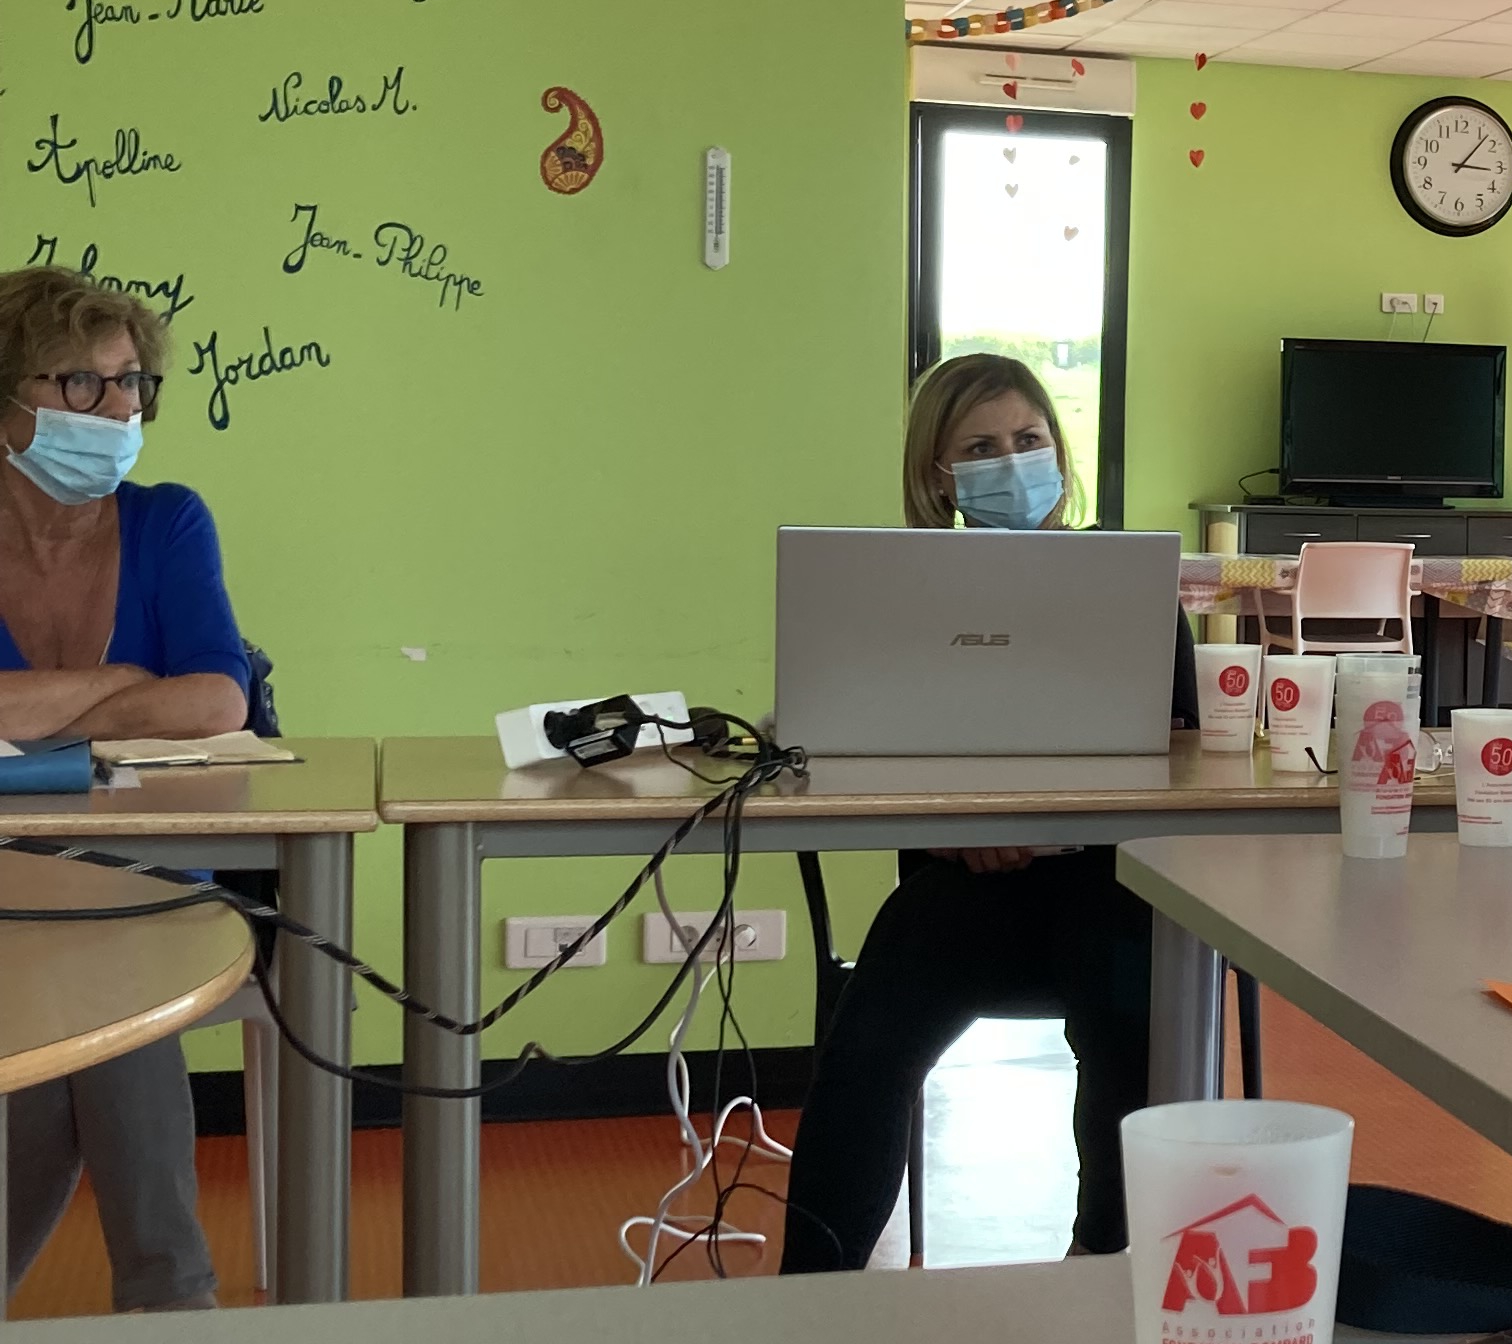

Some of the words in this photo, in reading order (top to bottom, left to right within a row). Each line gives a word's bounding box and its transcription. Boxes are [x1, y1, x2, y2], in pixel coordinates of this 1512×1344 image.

[258, 71, 367, 123] Nicolas
[1438, 125, 1451, 139] 11
[1454, 119, 1470, 134] 12
[1424, 139, 1440, 154] 10
[1488, 140, 1498, 154] 2
[27, 113, 183, 209] Apolline
[1417, 156, 1428, 170] 9
[1494, 161, 1505, 175] 3
[1422, 176, 1433, 190] 8
[1486, 180, 1497, 194] 4
[1438, 191, 1448, 205] 7
[1454, 197, 1465, 212] 6
[1475, 194, 1485, 208] 5
[187, 325, 331, 432] Jordan
[949, 633, 1011, 646] ASUS
[1226, 670, 1246, 689] 50
[1275, 683, 1294, 704] 50
[1491, 744, 1512, 766] 50
[1161, 1225, 1319, 1316] AFB
[1162, 1317, 1316, 1339] Association
